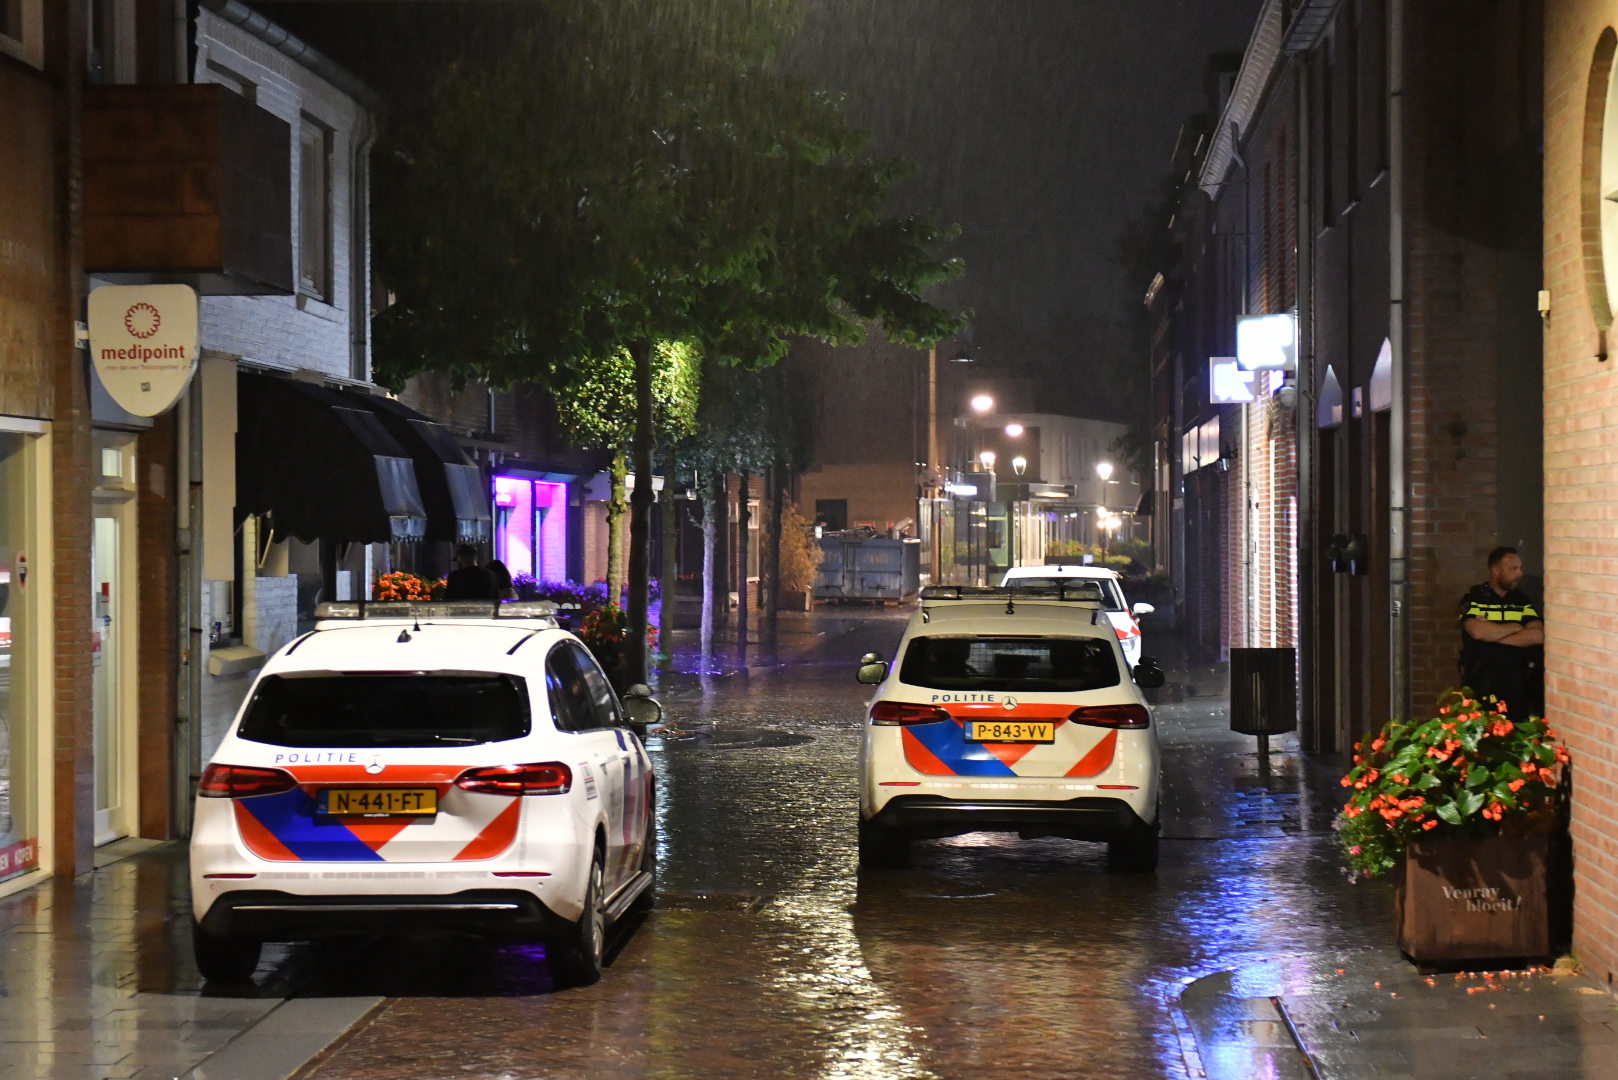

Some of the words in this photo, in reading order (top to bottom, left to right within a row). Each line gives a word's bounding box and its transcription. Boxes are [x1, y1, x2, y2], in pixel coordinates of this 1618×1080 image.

[101, 344, 185, 363] medipoint
[931, 694, 995, 703] POLITIE
[978, 725, 1047, 738] P-843-VV
[275, 752, 357, 764] POLITIE
[337, 792, 425, 811] N-441-FT
[1442, 886, 1500, 901] Venray
